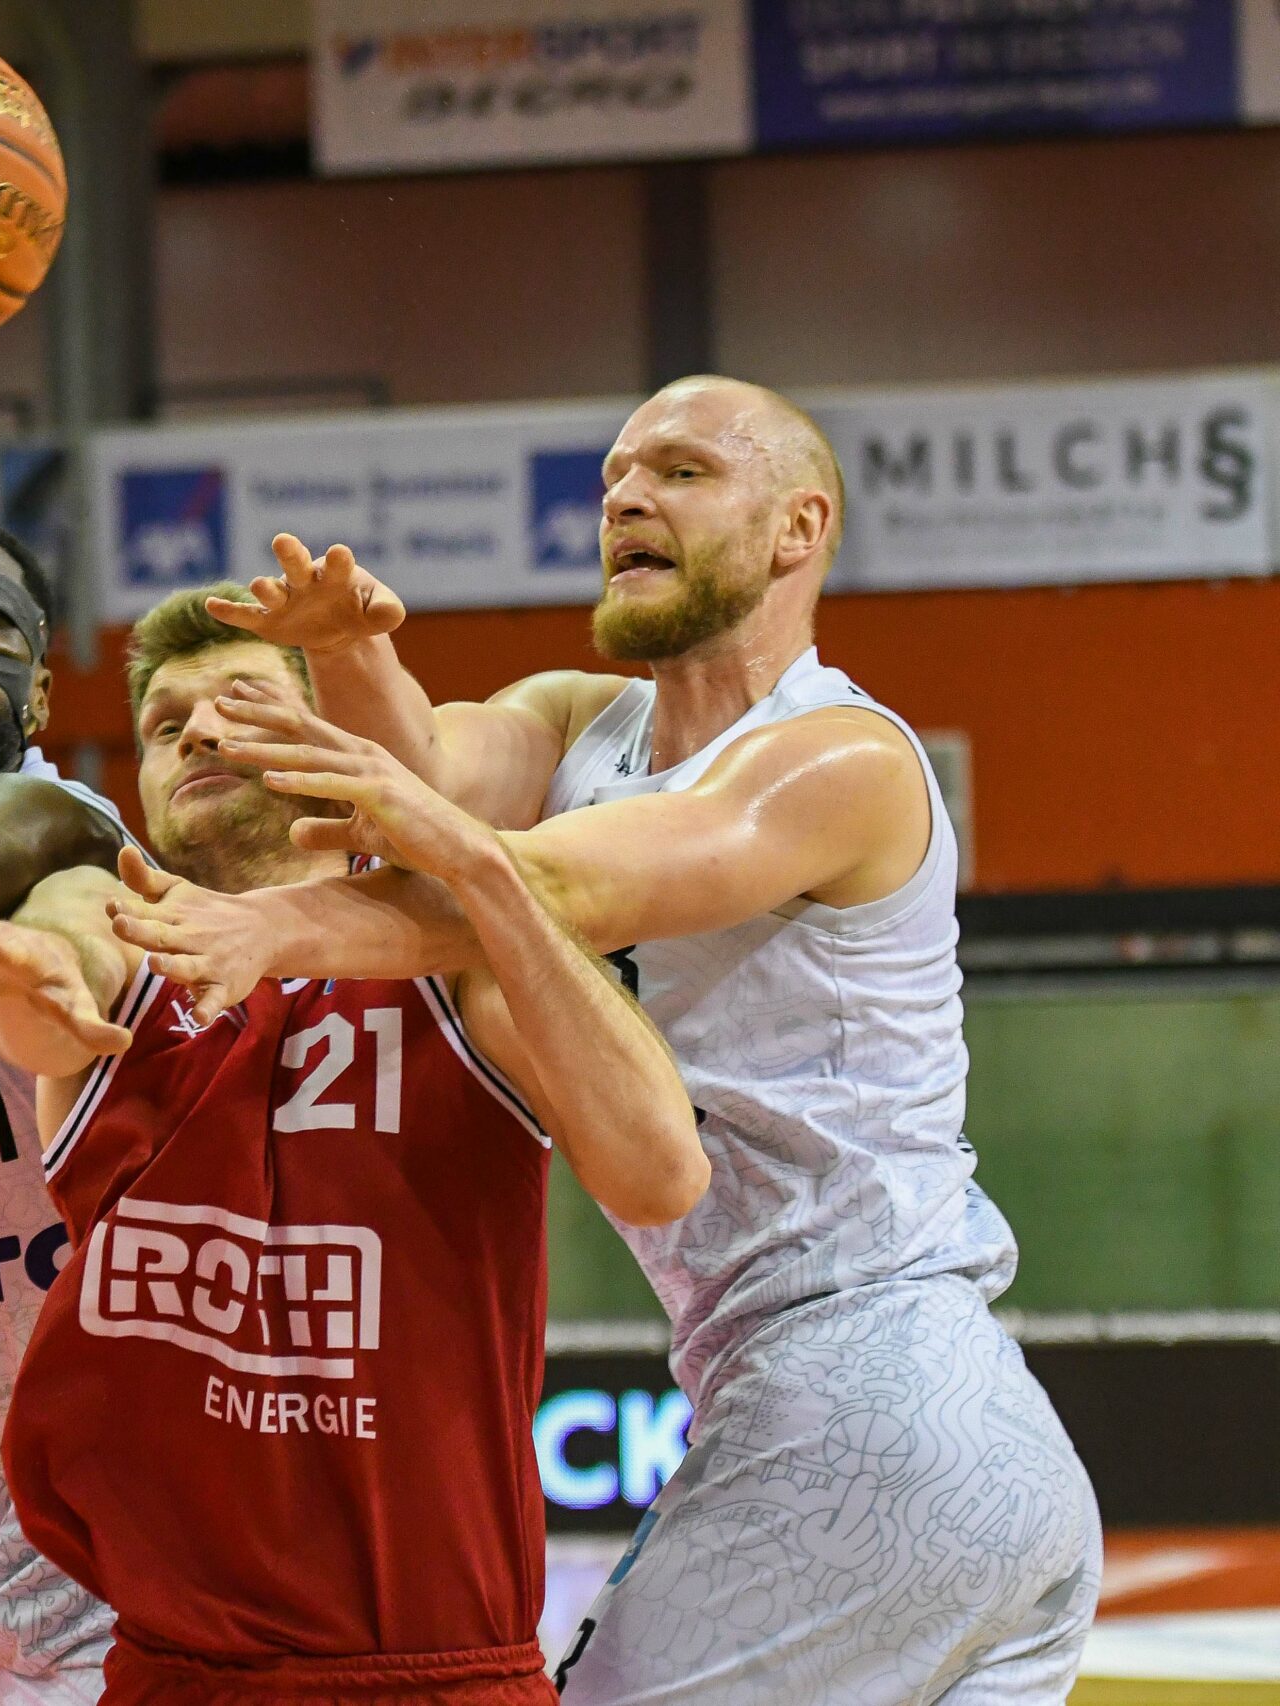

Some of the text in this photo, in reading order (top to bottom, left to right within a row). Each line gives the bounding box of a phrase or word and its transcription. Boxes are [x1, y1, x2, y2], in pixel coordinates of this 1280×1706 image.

[273, 1007, 403, 1134] 21
[110, 1225, 354, 1349] ROTH
[204, 1375, 377, 1439] ENERGIE
